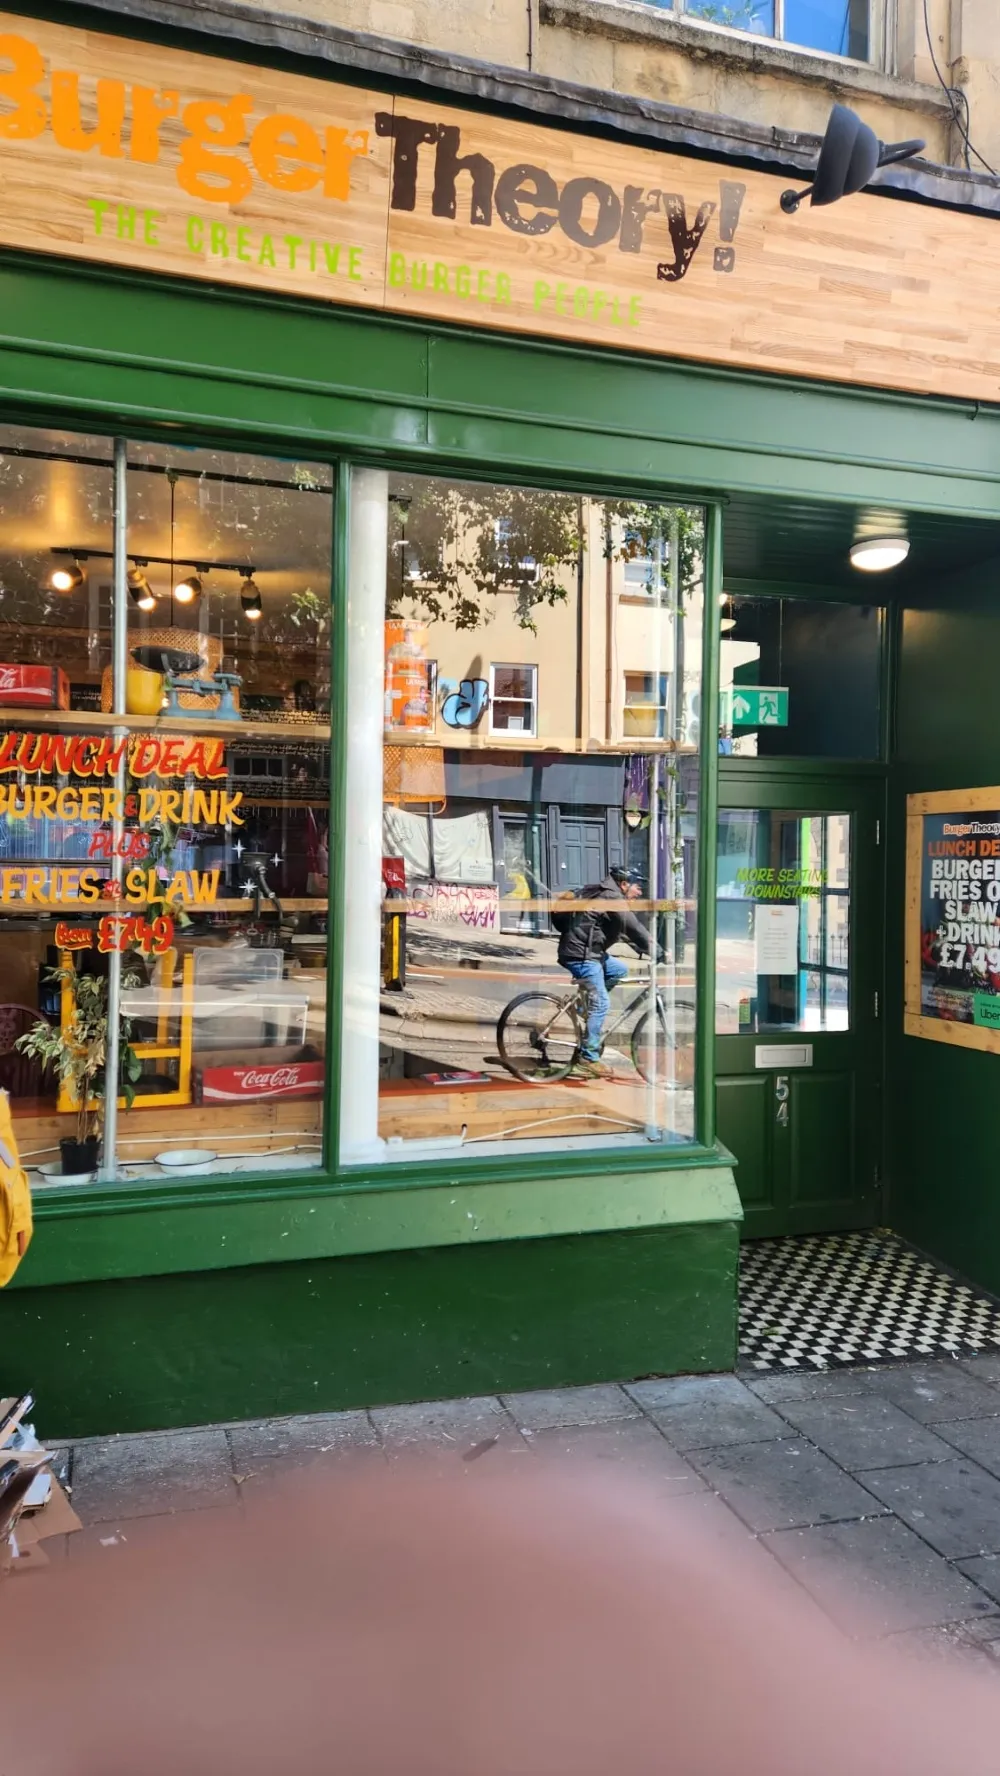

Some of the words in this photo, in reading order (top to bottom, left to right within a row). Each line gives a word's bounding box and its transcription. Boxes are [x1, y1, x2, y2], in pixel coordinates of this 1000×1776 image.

[87, 199, 161, 247] THE
[185, 215, 364, 281] CREATIVE
[389, 253, 511, 307] BURGER
[533, 279, 644, 327] PEOPLE
[0, 731, 127, 778] LUNCH
[129, 737, 229, 780] DEAL
[138, 789, 245, 826] DRINK
[88, 831, 151, 859] PLUS
[928, 840, 976, 857] LUNCH
[1, 867, 100, 905] FRIES
[125, 868, 221, 905] SLAW
[736, 867, 775, 882] MORE
[777, 868, 828, 883] SEATING
[744, 883, 822, 899] DOWNSTAIRS
[930, 880, 982, 901] FRIES
[945, 900, 998, 923] SLAW
[939, 943, 1000, 974] £7.49
